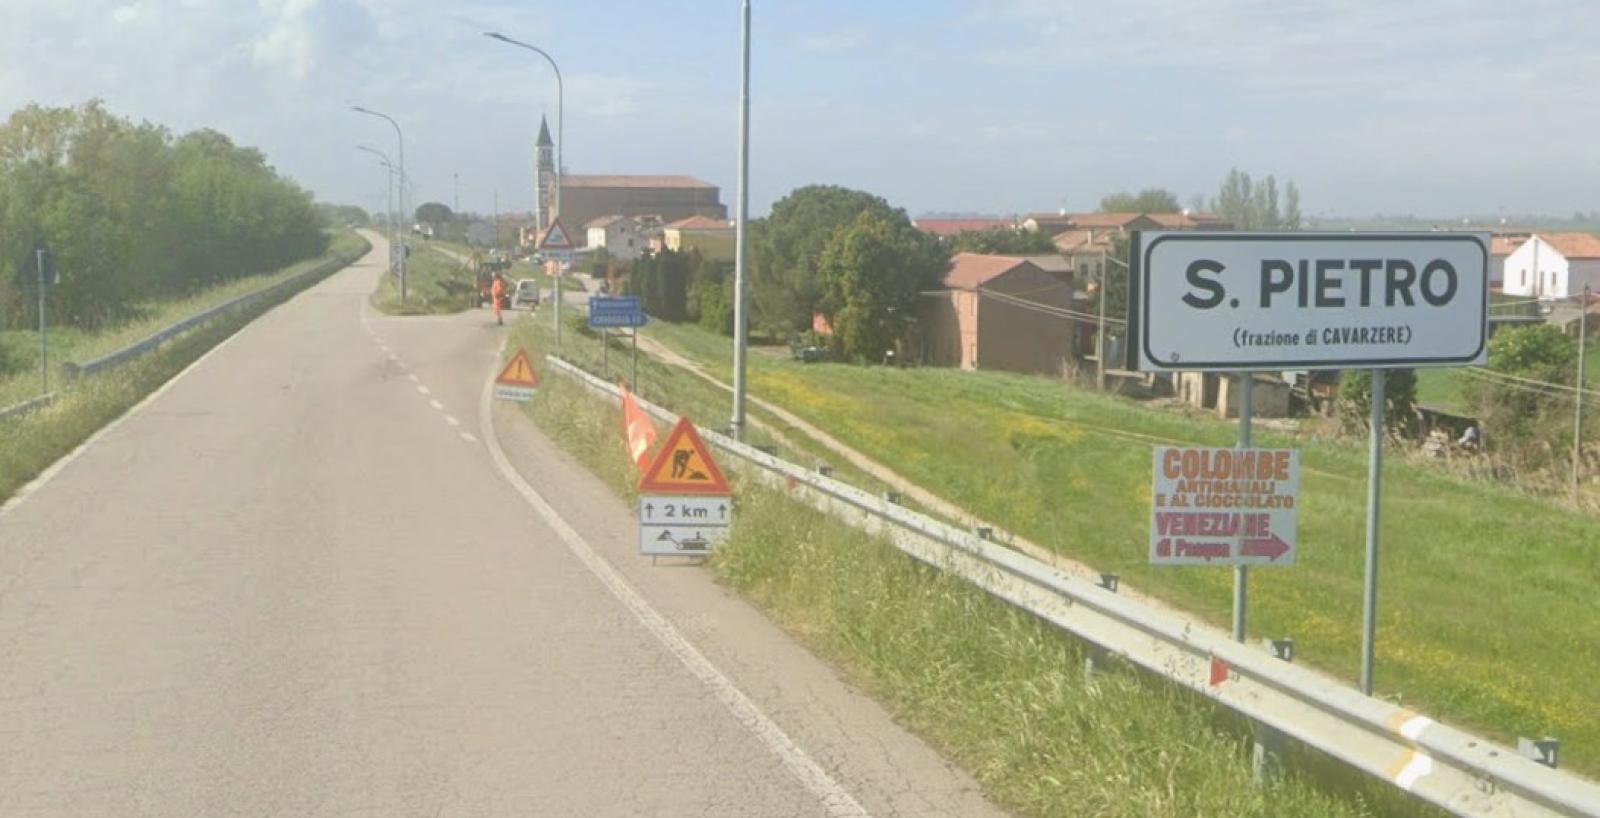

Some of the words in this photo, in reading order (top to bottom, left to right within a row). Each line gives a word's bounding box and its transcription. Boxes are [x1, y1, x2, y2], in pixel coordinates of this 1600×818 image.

[1181, 259, 1240, 310] S.
[1259, 258, 1458, 309] PIETRO
[1233, 327, 1300, 347] (frazione
[1304, 328, 1319, 346] di
[1322, 325, 1413, 345] CAVARZERE)
[1163, 449, 1290, 480] COLOMBE
[663, 504, 675, 518] 2
[682, 504, 708, 518] km
[1156, 494, 1167, 507] E
[1171, 495, 1189, 507] AL
[1195, 495, 1294, 508] CIOCCOLATO
[1155, 512, 1270, 537] VENEZIANE
[1156, 538, 1171, 557] di
